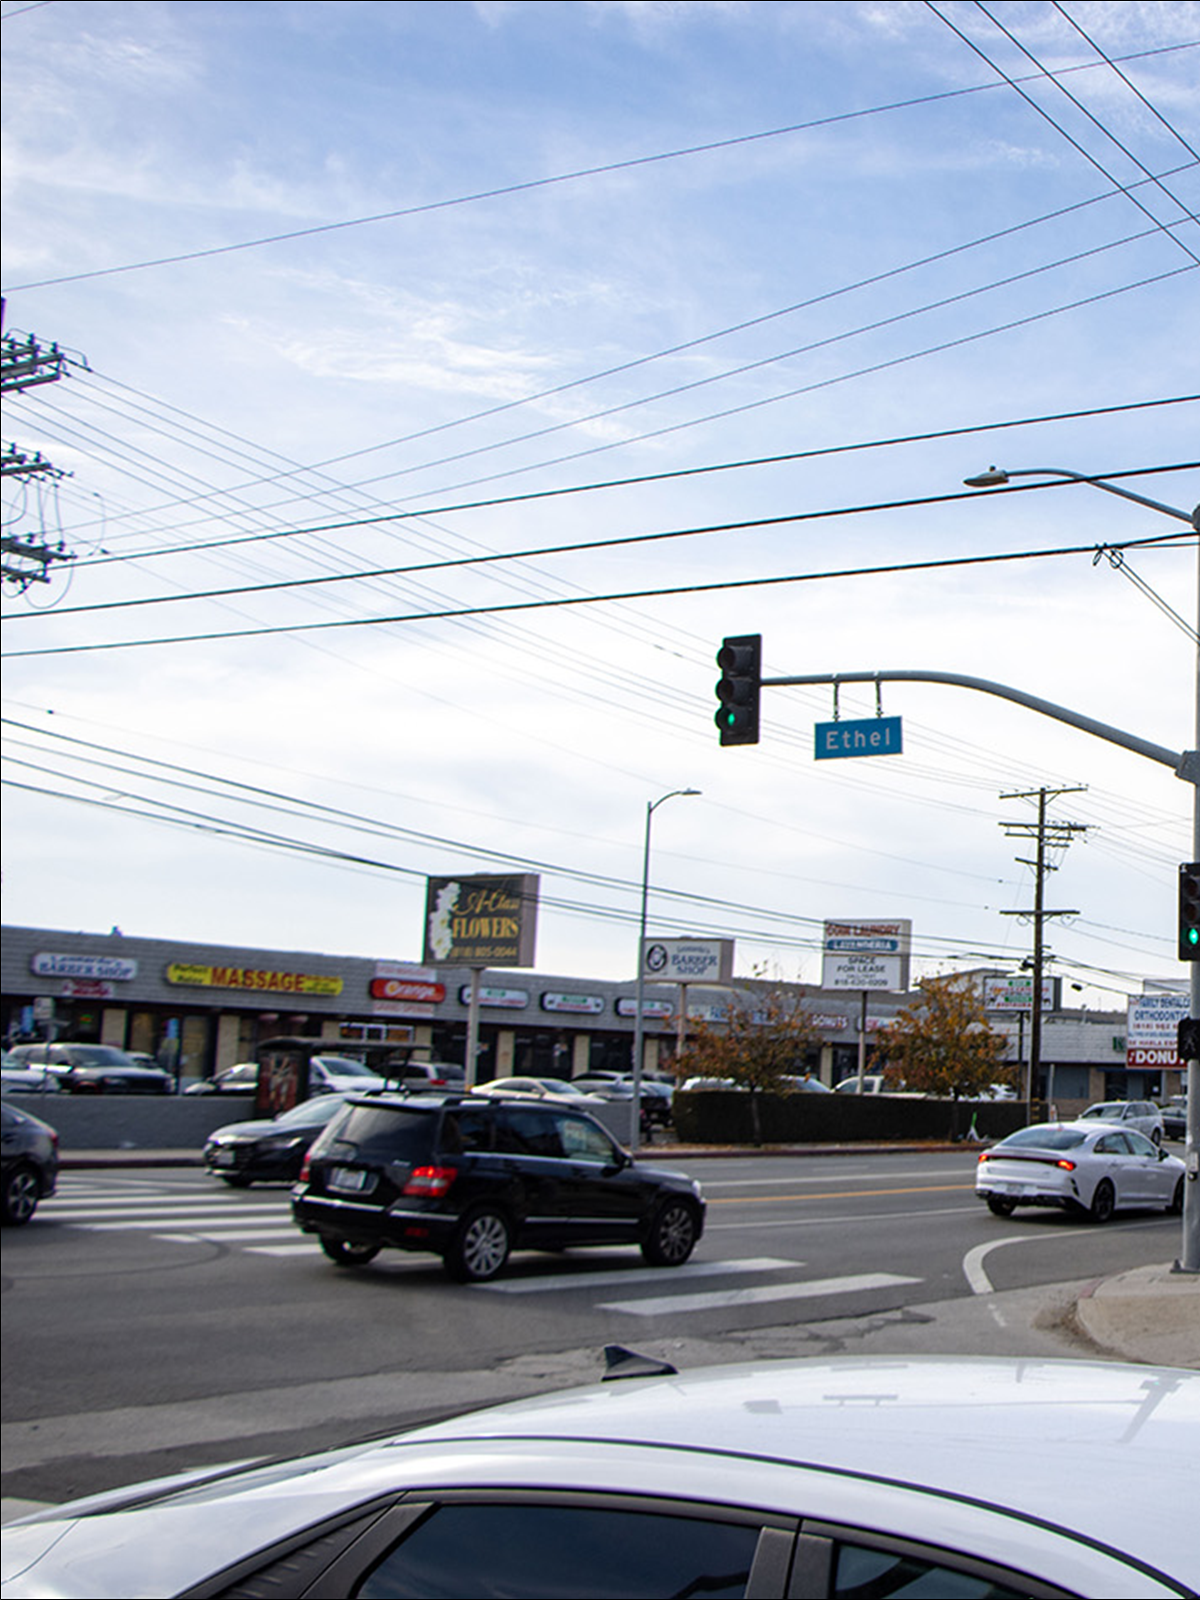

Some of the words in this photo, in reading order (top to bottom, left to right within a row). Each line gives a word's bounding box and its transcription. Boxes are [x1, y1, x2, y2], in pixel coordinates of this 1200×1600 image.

[826, 727, 890, 750] Ethel
[452, 917, 519, 939] FLOWERS
[671, 954, 718, 966] BARBER
[848, 956, 876, 965] SPACE
[39, 962, 93, 974] BARBER
[96, 966, 133, 978] SHOP
[677, 965, 709, 975] SHOP
[837, 965, 855, 973] FOR
[858, 965, 886, 973] LEASE
[211, 967, 305, 992] MASSAGE
[384, 980, 436, 999] Orange
[1135, 1050, 1184, 1065] DONU
